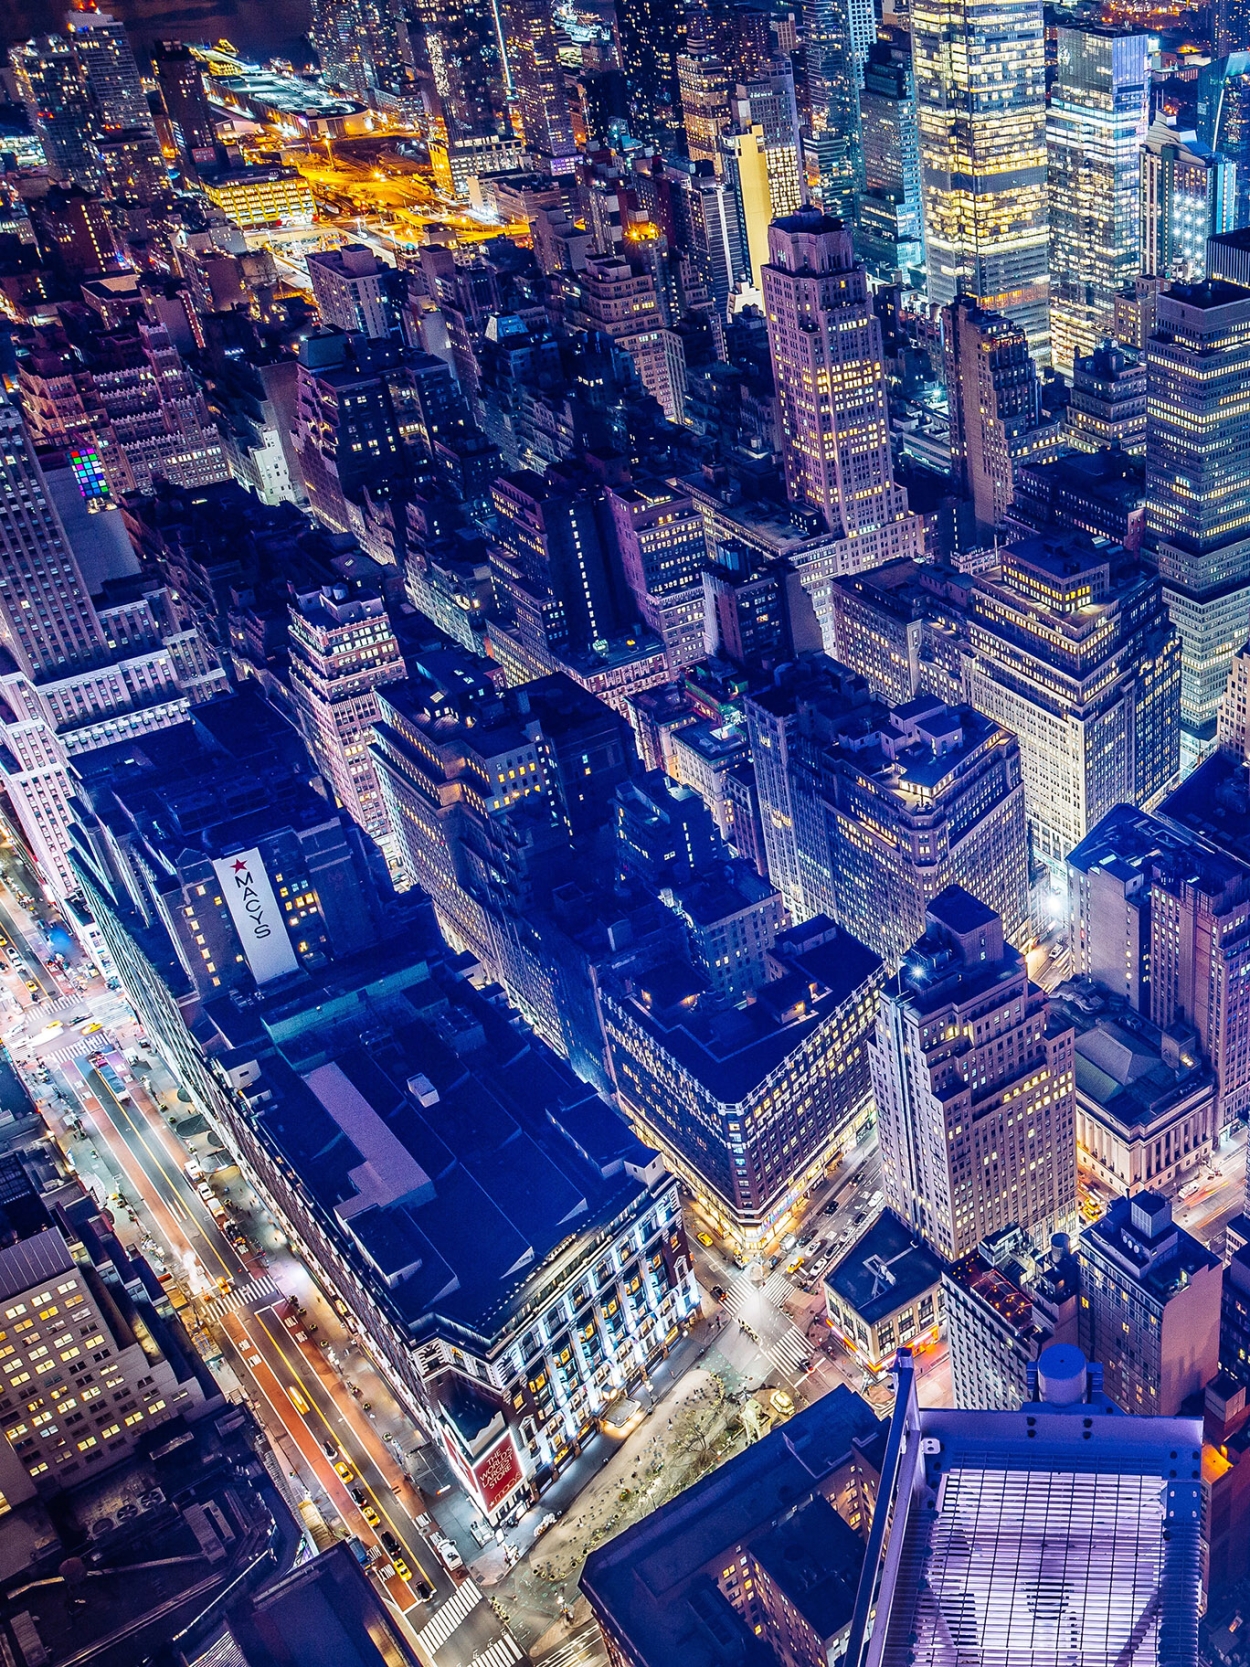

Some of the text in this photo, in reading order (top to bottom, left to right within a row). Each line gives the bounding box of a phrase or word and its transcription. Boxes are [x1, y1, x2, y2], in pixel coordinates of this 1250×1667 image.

[235, 871, 271, 939] MACYS
[480, 1445, 513, 1481] WORLD'S
[481, 1454, 513, 1488] LARGEST
[485, 1448, 501, 1466] THE
[489, 1464, 512, 1490] STORE
[377, 1563, 396, 1581] ONLY
